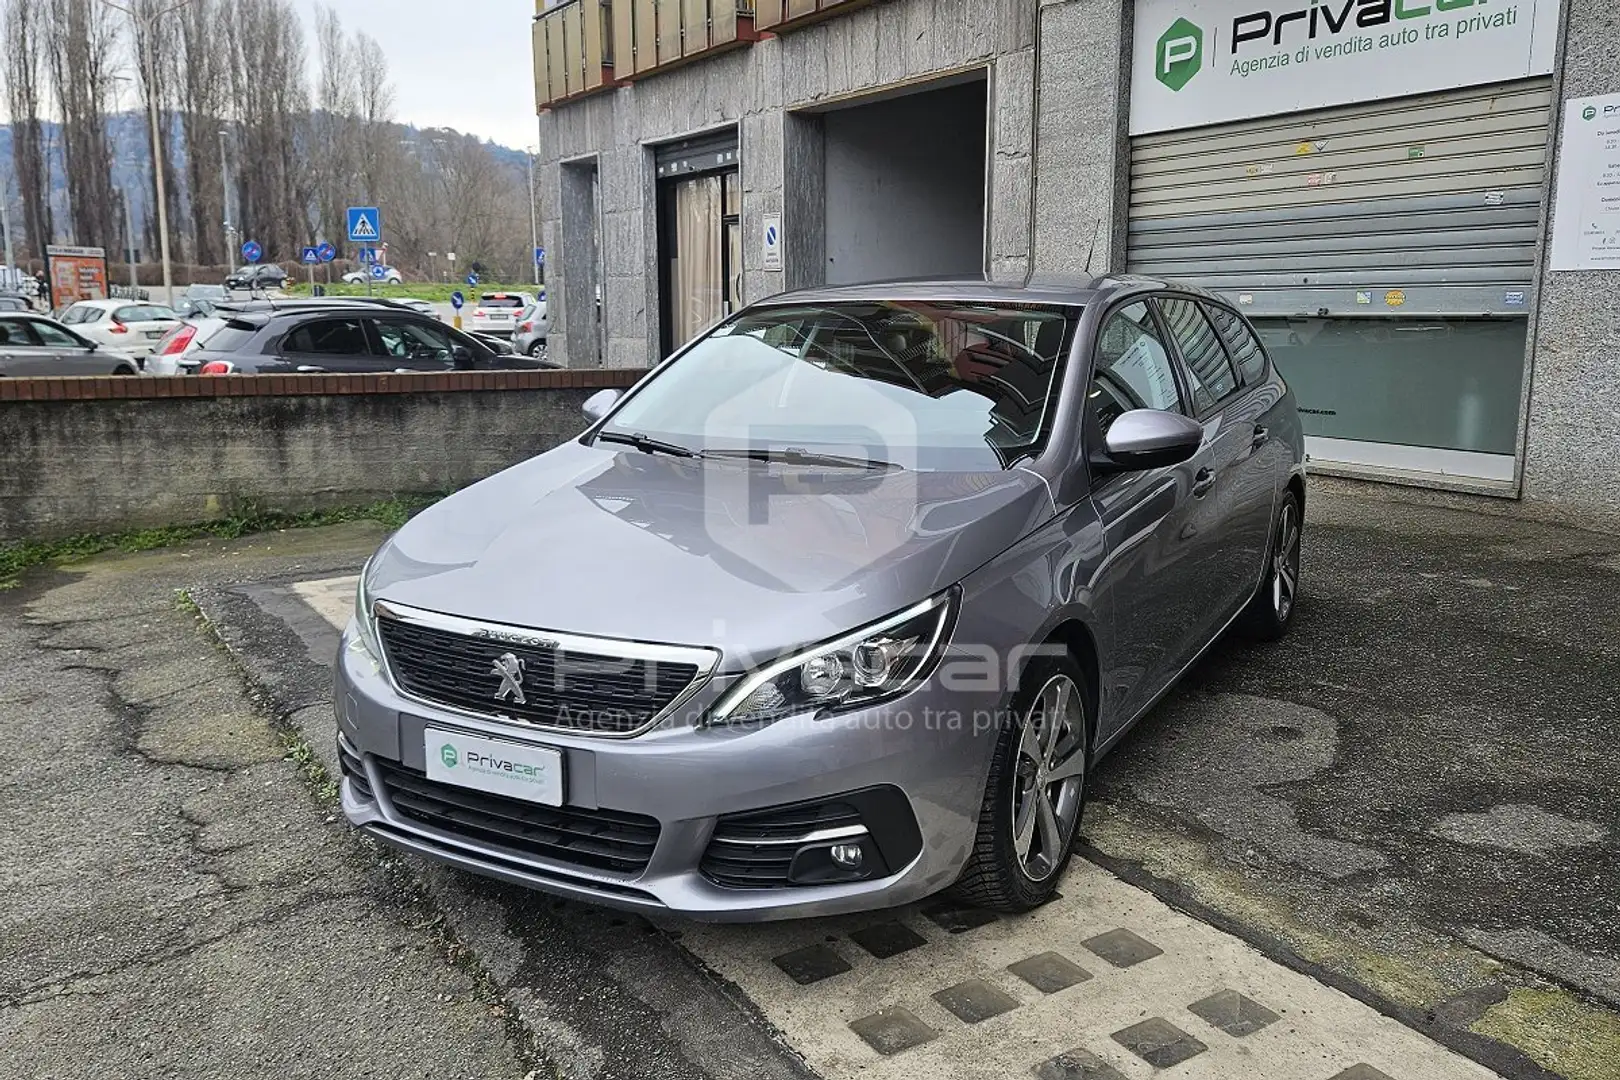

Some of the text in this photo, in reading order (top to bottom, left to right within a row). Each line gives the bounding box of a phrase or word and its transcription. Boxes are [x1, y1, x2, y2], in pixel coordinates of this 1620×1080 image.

[1230, 5, 1518, 77] Agenzia di vendita auto tra privati
[1231, 0, 1488, 54] Privac
[1164, 35, 1197, 74] P
[467, 751, 546, 777] Privacar
